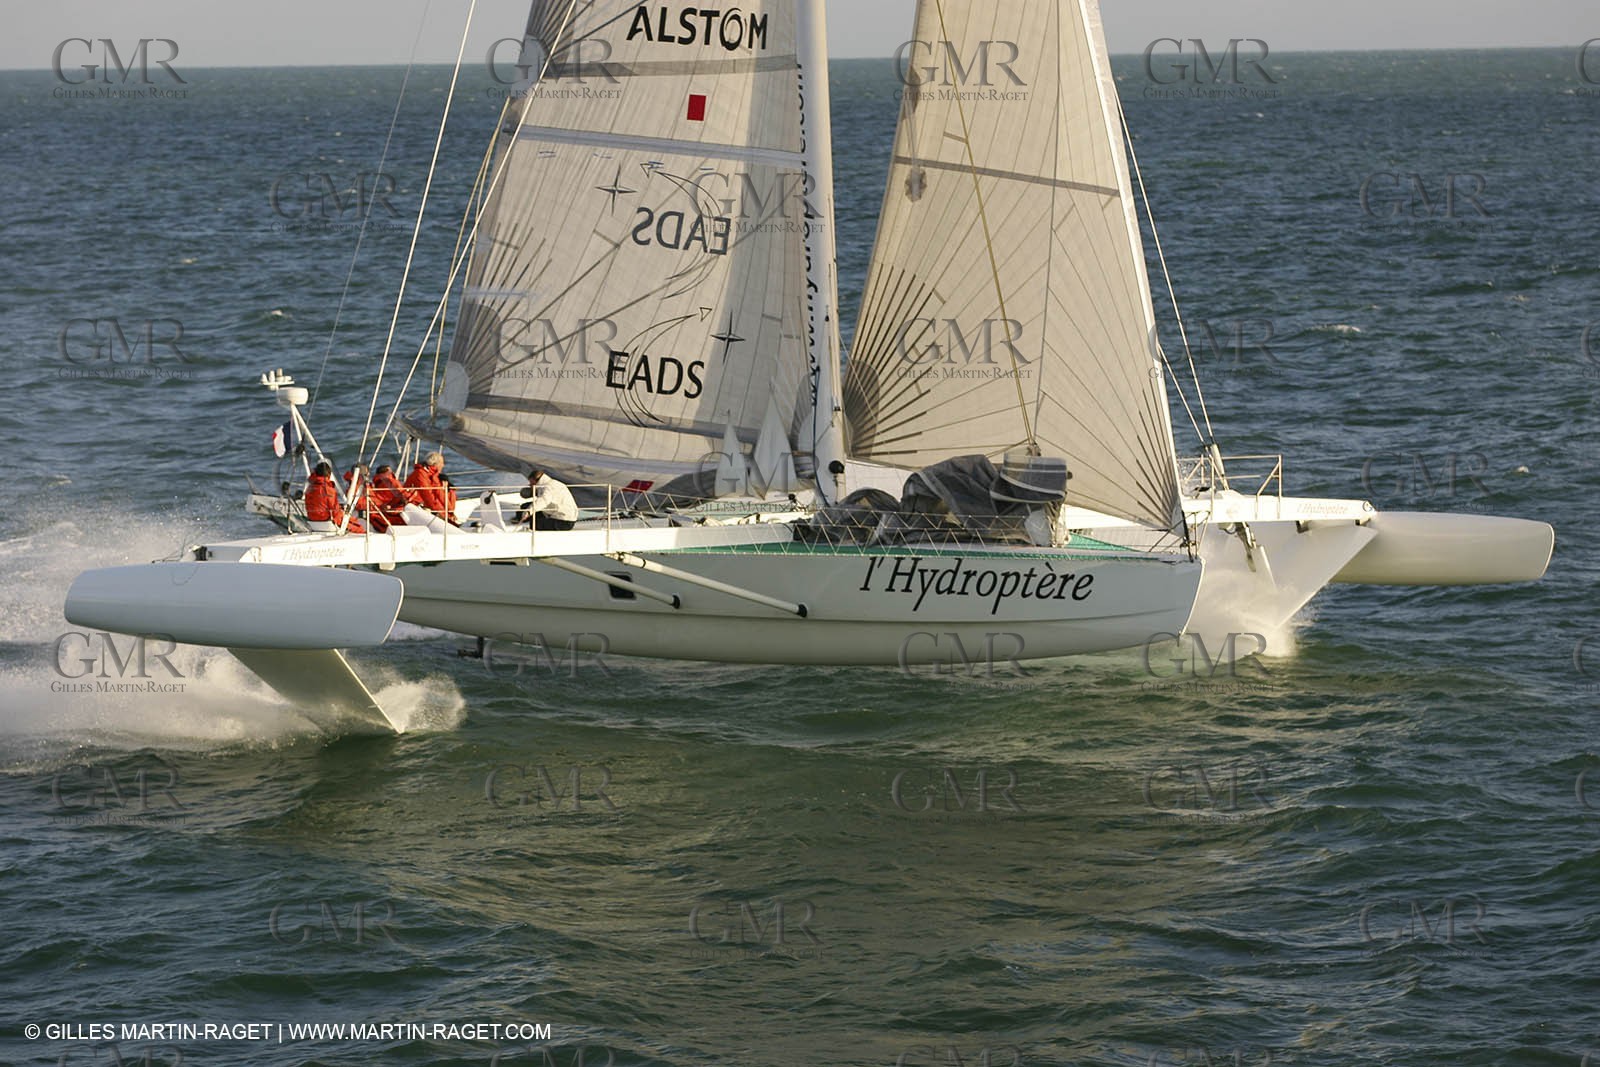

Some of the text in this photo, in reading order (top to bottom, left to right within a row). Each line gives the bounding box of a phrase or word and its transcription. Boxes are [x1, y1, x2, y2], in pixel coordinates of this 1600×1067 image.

[626, 6, 768, 50] ALSTOM
[606, 351, 704, 399] EADS
[860, 557, 1094, 615] l'Hydroptère
